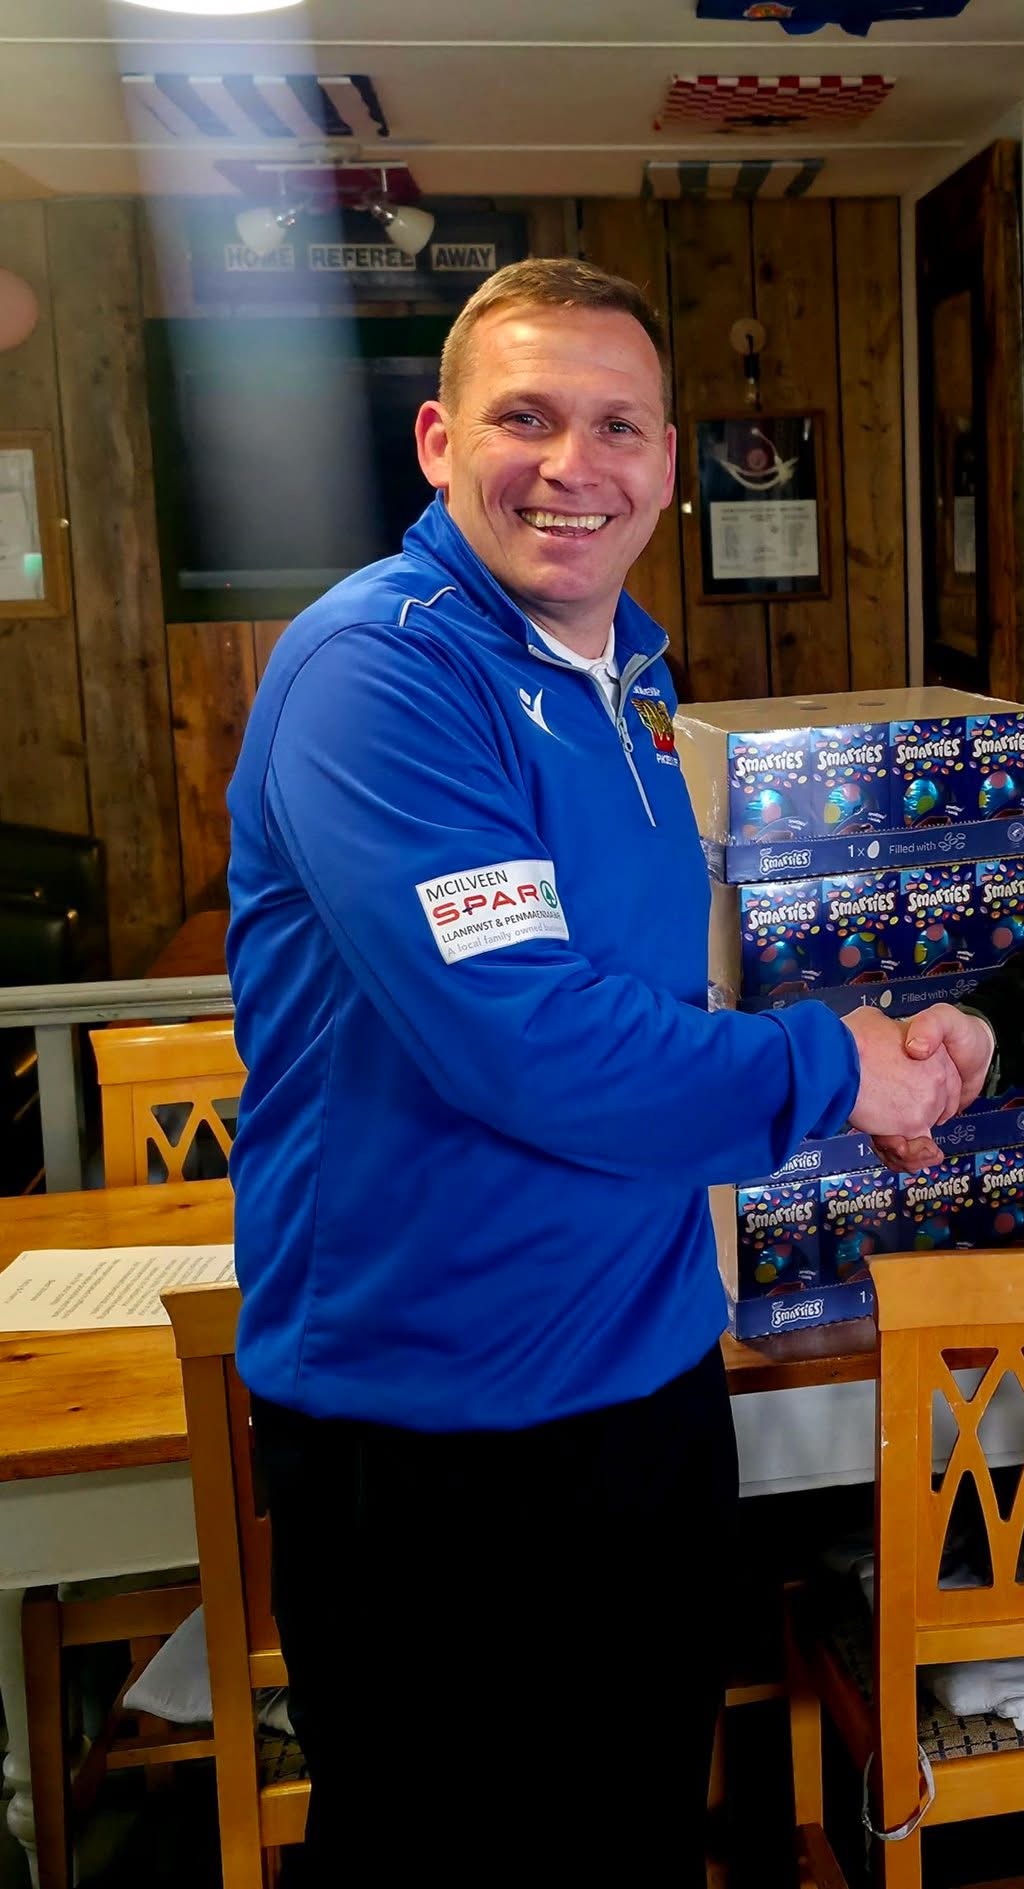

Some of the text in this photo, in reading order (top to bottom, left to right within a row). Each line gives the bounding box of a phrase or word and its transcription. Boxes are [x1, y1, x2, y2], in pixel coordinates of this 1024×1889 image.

[227, 247, 293, 267] HOME
[312, 247, 414, 267] REFEREE
[435, 247, 494, 267] AWAY
[889, 844, 915, 854] Filled
[916, 841, 937, 852] with
[425, 870, 508, 902] MCILVEEN
[432, 884, 541, 926] SPAR
[442, 920, 494, 943] LLANRWST
[495, 918, 504, 928] &
[457, 936, 482, 952] local
[483, 929, 512, 945] family
[515, 923, 543, 936] owned
[901, 991, 927, 1003] Filled
[928, 988, 949, 1000] with
